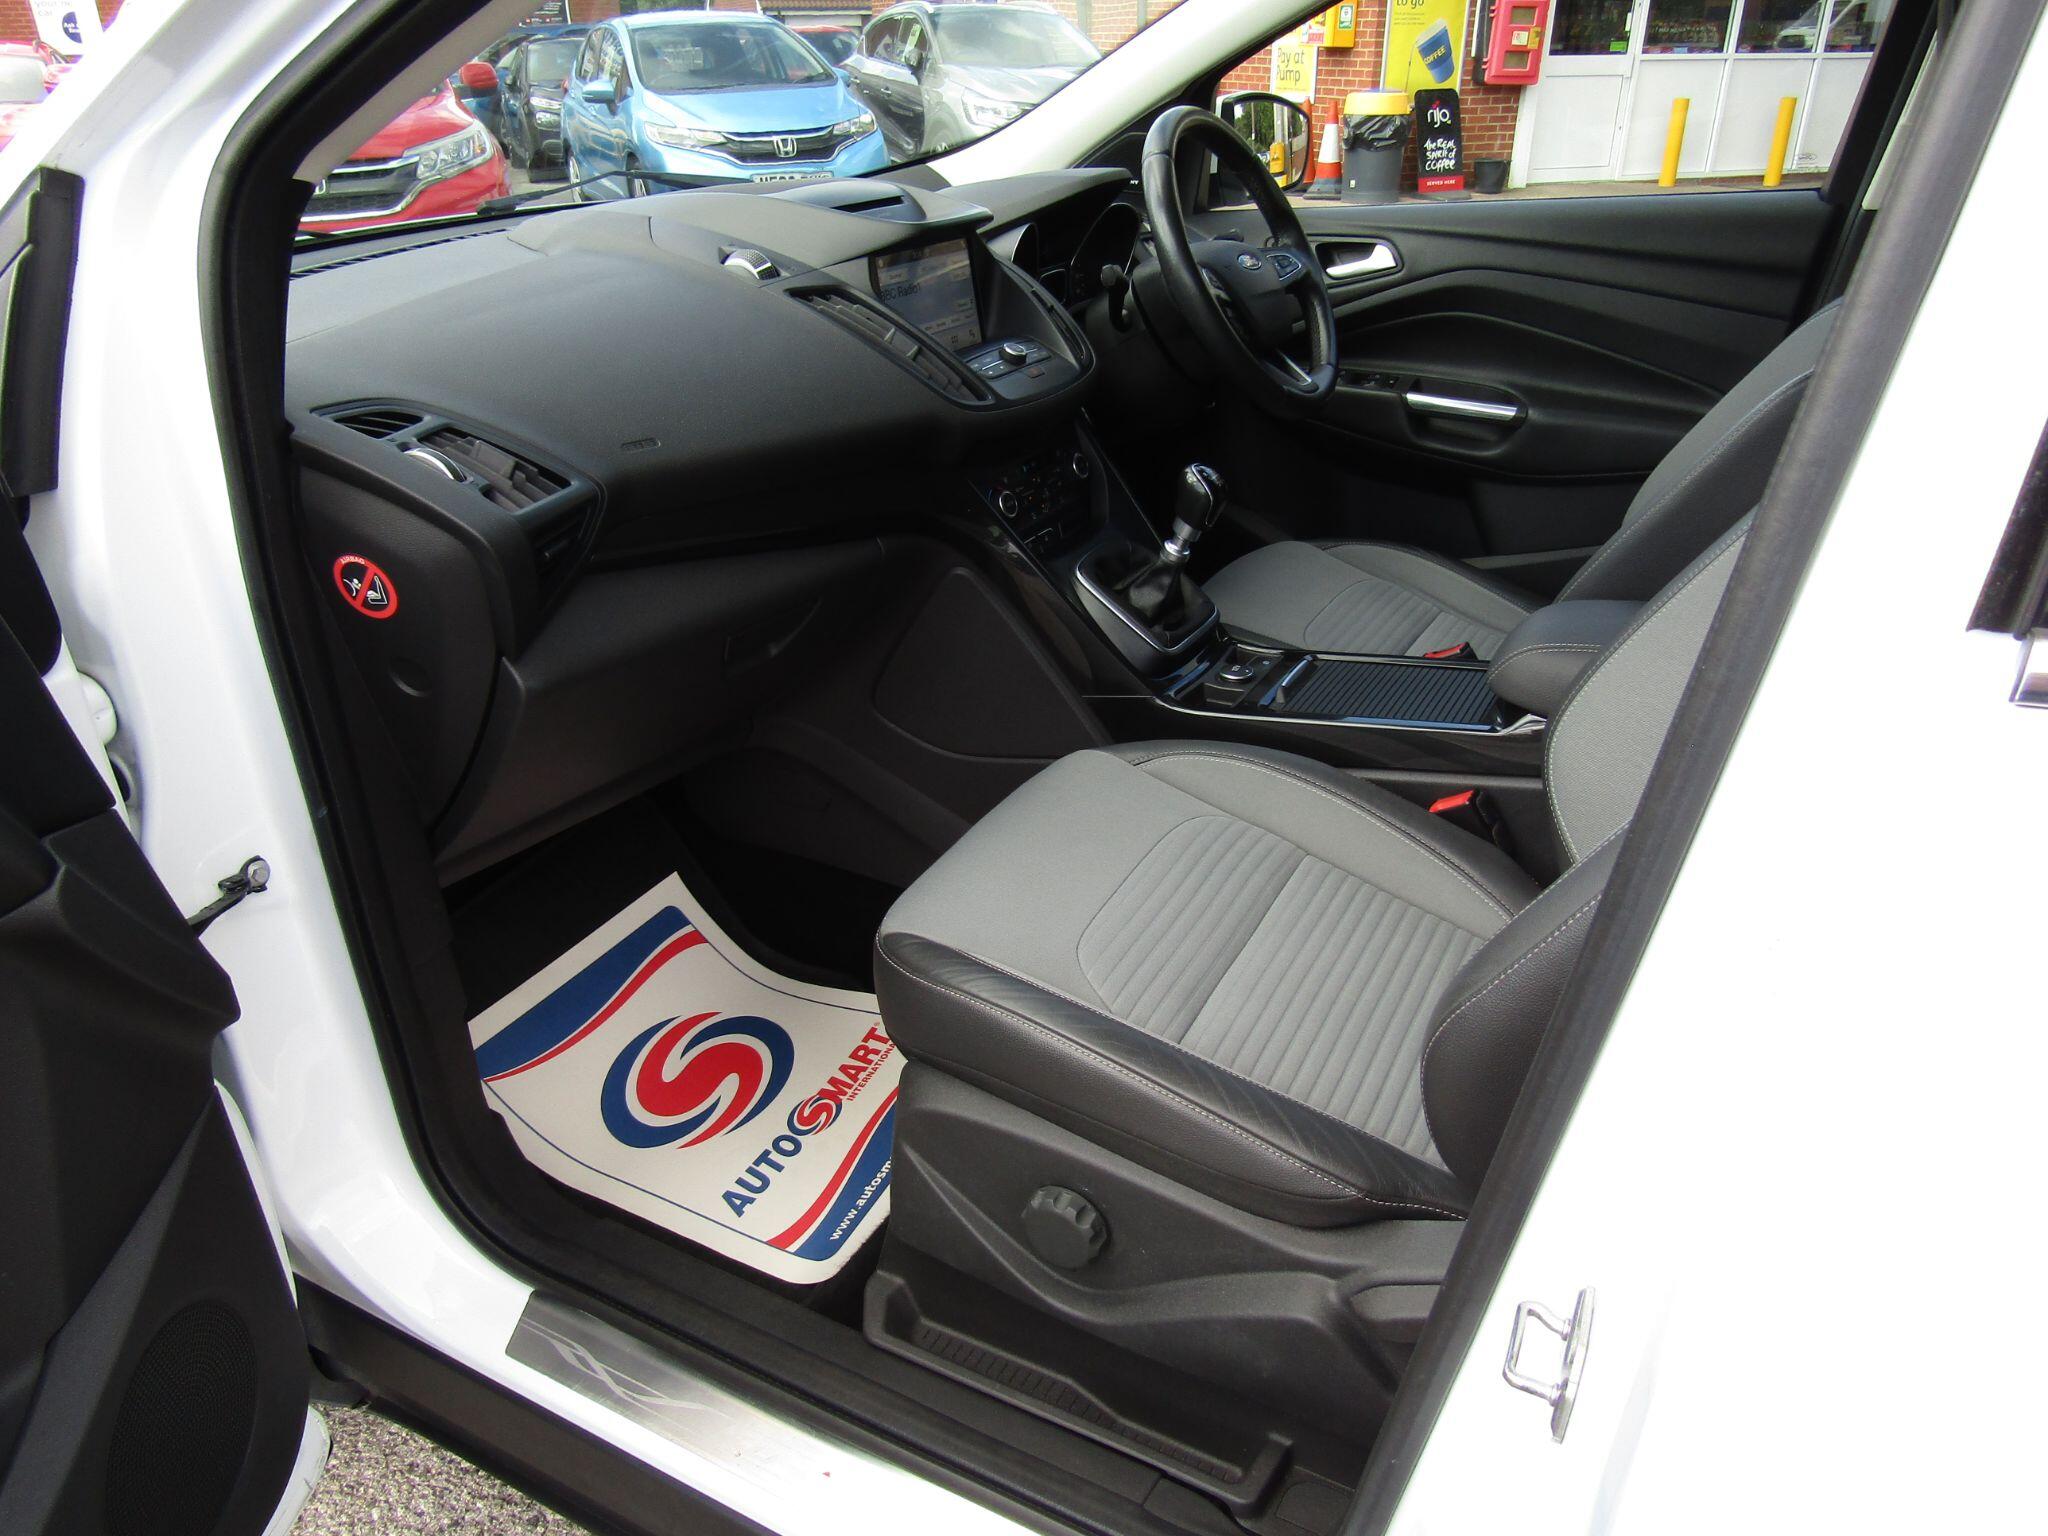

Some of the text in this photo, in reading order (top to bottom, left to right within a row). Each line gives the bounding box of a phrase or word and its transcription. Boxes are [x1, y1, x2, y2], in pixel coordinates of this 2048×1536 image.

[1277, 47, 1305, 68] Pay at
[1423, 45, 1446, 65] COFFEE
[1276, 65, 1301, 86] Pump
[846, 1042, 897, 1101] INTERNATIONA
[830, 1156, 892, 1241] www.autosm
